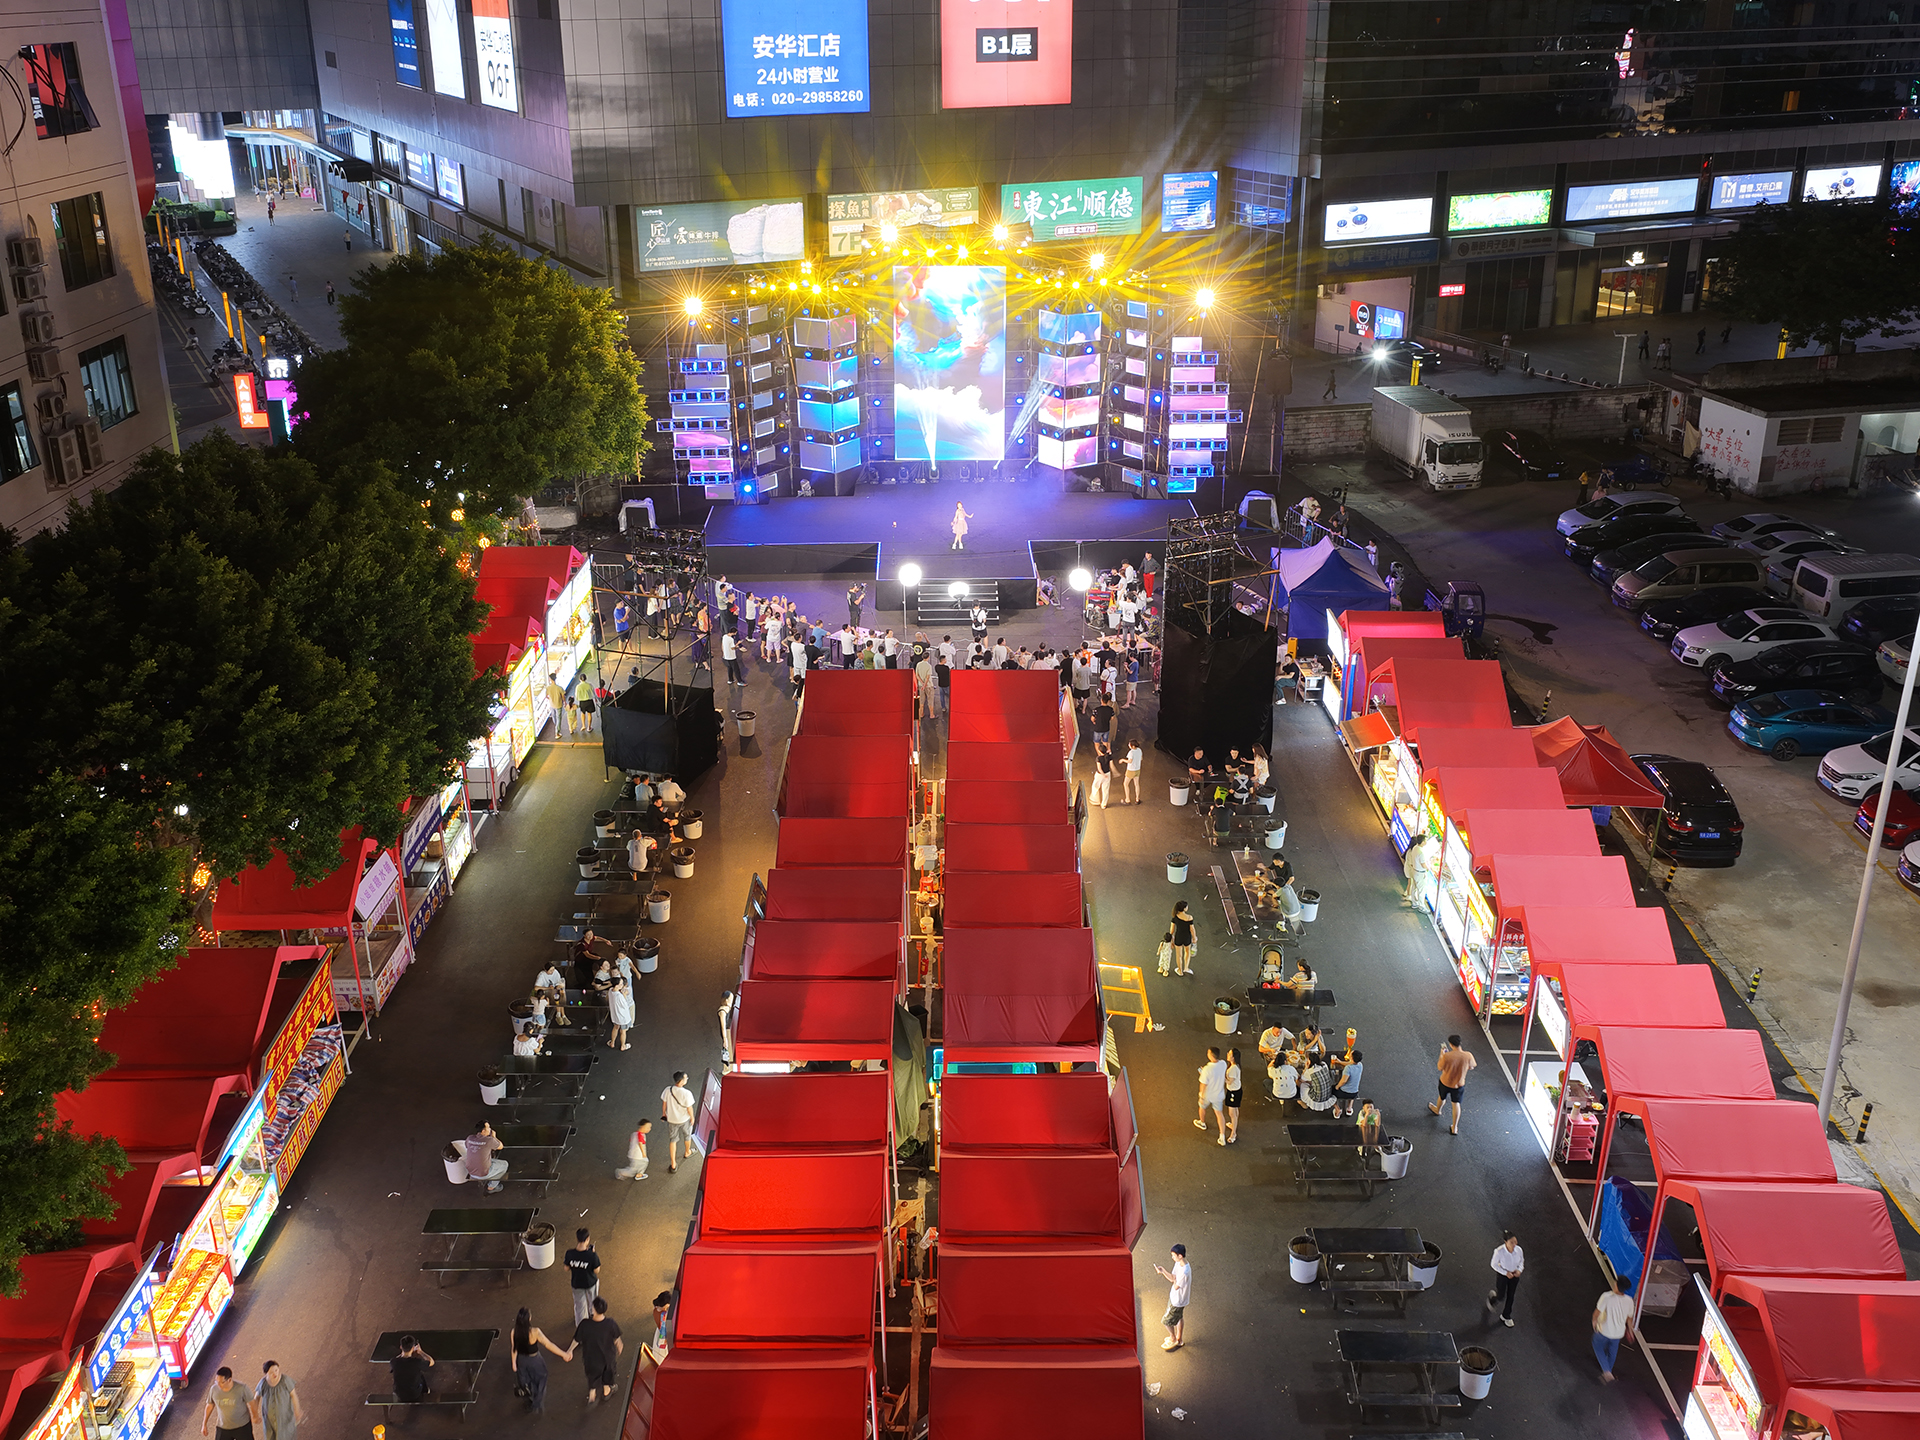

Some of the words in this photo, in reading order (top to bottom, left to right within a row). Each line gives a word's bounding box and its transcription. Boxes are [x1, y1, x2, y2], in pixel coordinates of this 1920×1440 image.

[752, 33, 841, 58] 安华汇店
[982, 34, 1032, 55] B1层
[756, 66, 839, 85] 24小时营业
